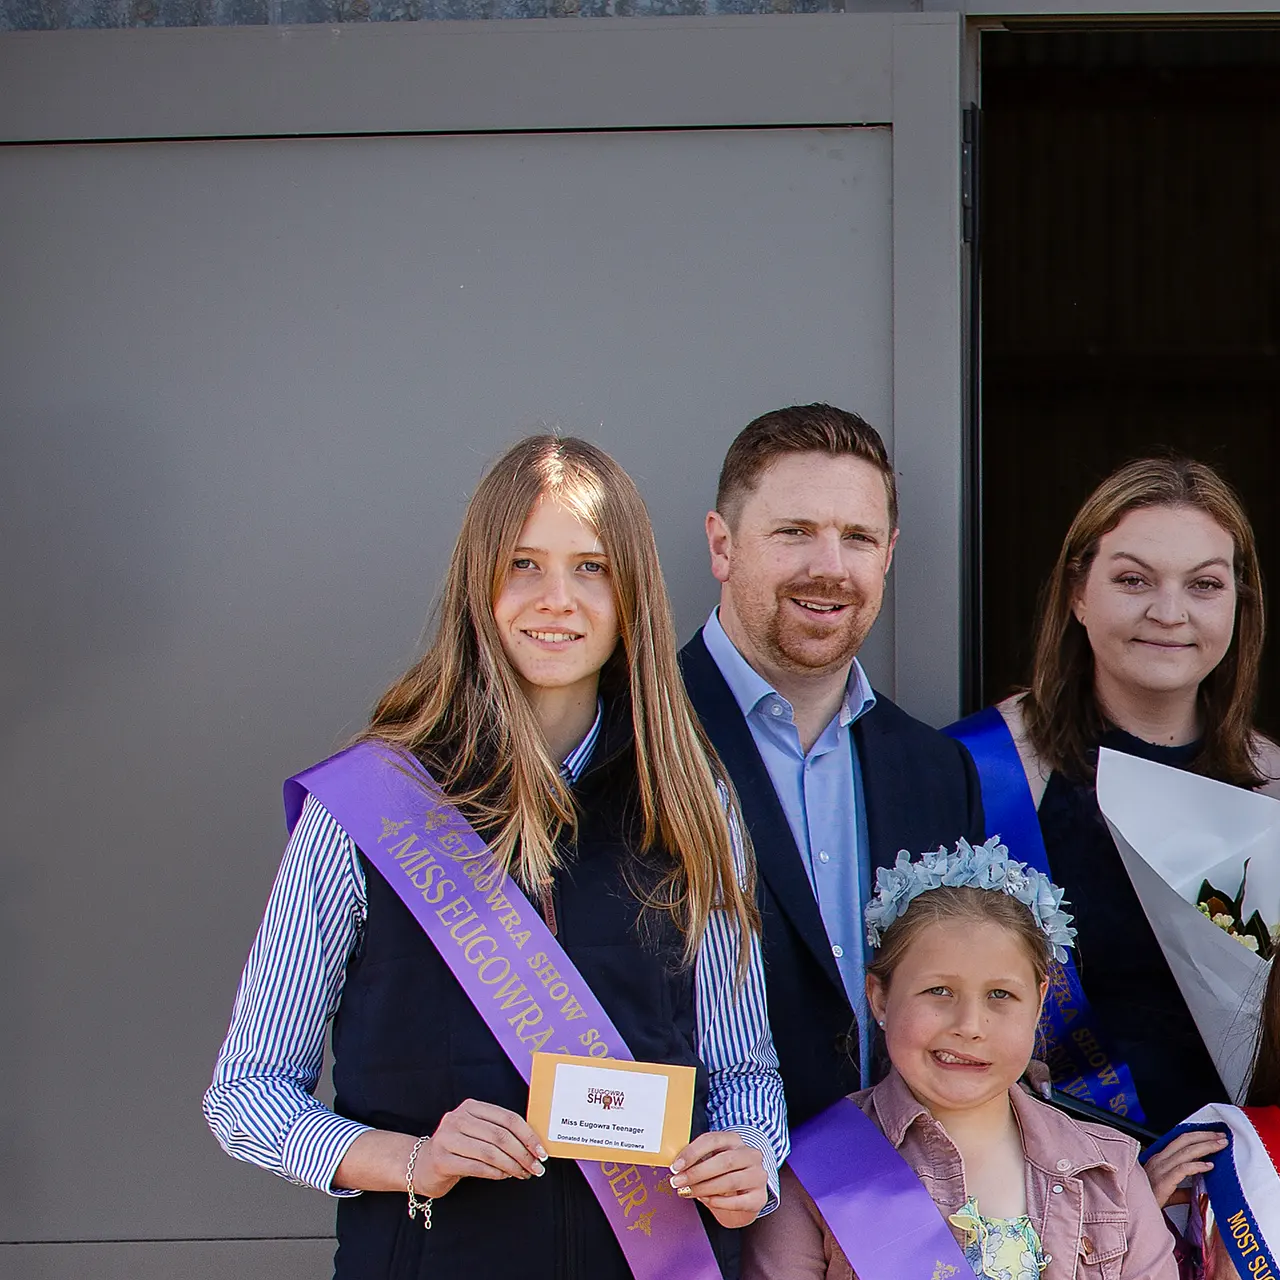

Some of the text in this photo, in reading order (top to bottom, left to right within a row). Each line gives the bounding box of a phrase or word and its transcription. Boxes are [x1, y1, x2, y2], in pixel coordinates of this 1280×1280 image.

[387, 833, 457, 904] MISS
[435, 895, 555, 1055] EUGOWRA
[438, 832, 532, 950] EUGOWRA
[526, 951, 588, 1022] SHOW
[1072, 1028, 1121, 1087] SHOW
[587, 1093, 624, 1108] SHOW
[557, 1134, 580, 1142] Donated
[620, 1141, 644, 1149] Eugowra
[561, 1118, 644, 1134] Miss Eugowra Teenager
[1226, 1210, 1260, 1257] MOST
